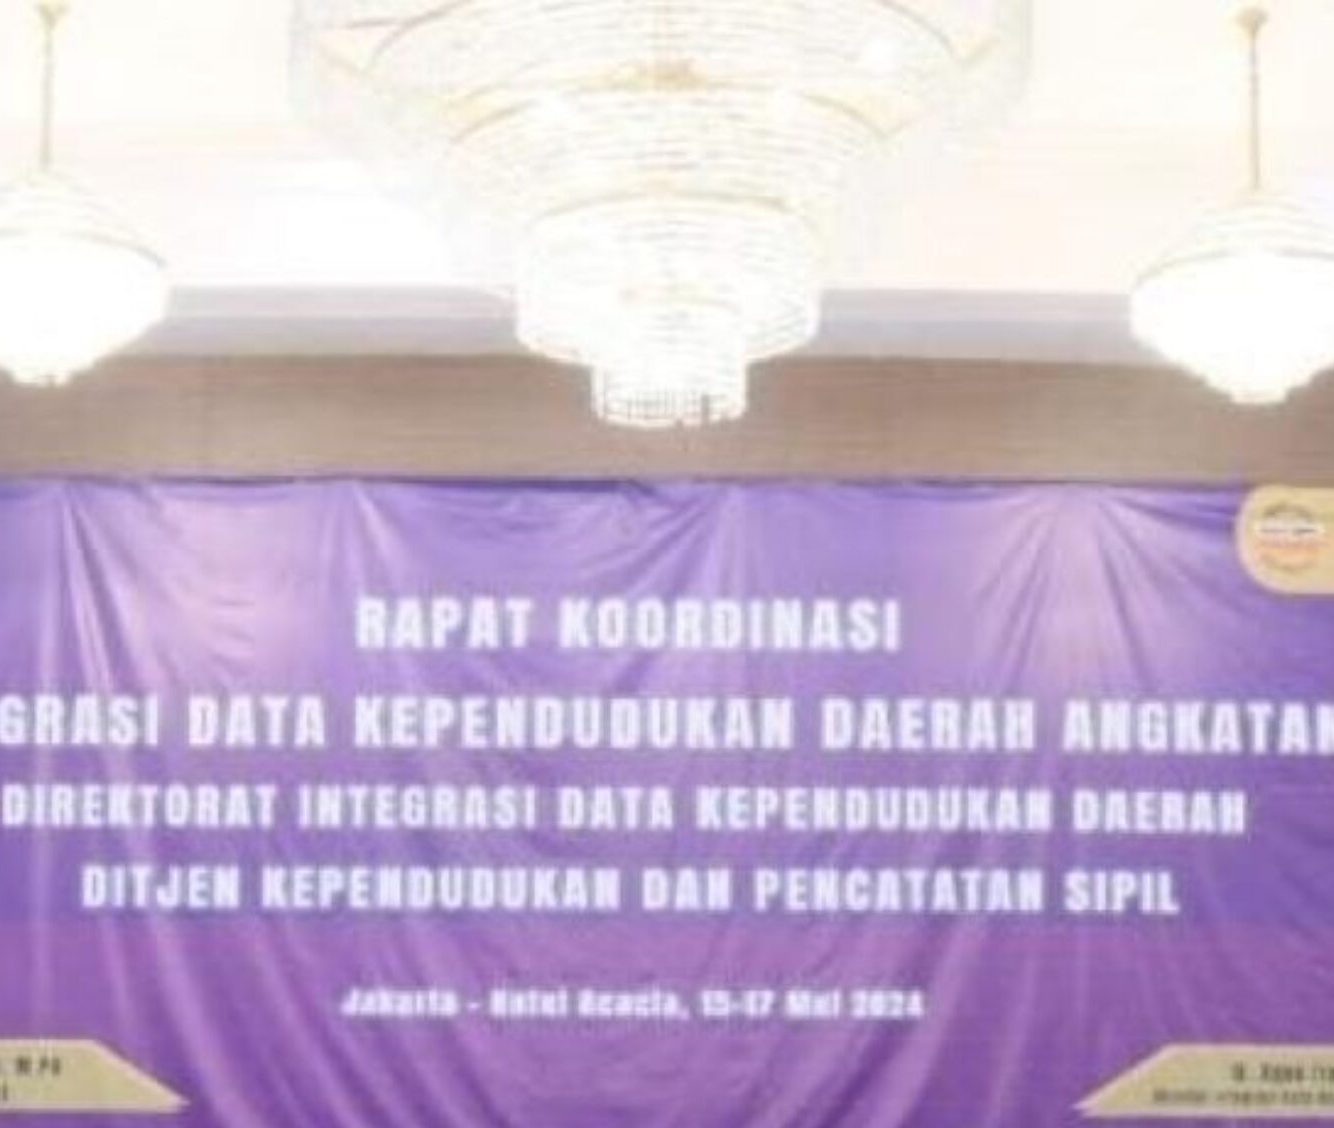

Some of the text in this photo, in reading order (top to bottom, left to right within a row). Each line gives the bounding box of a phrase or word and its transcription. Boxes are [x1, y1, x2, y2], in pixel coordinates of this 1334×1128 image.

[355, 597, 901, 650] RAPAT KOORDINASI
[188, 695, 326, 748] DATA
[354, 696, 793, 750] KEPENDUDUKAN
[822, 698, 1035, 752] DAERAH
[1, 783, 1248, 835] DIREKTORAT INTEGRASI DATA KEPENDUDUKAN DAERAH
[81, 864, 1181, 916] DITJEN KEPENDUDUKAN DAN PENCATATAN SIPIL
[341, 986, 460, 1017] Jakarta
[489, 987, 569, 1017] Hotel
[850, 988, 925, 1020] 2024
